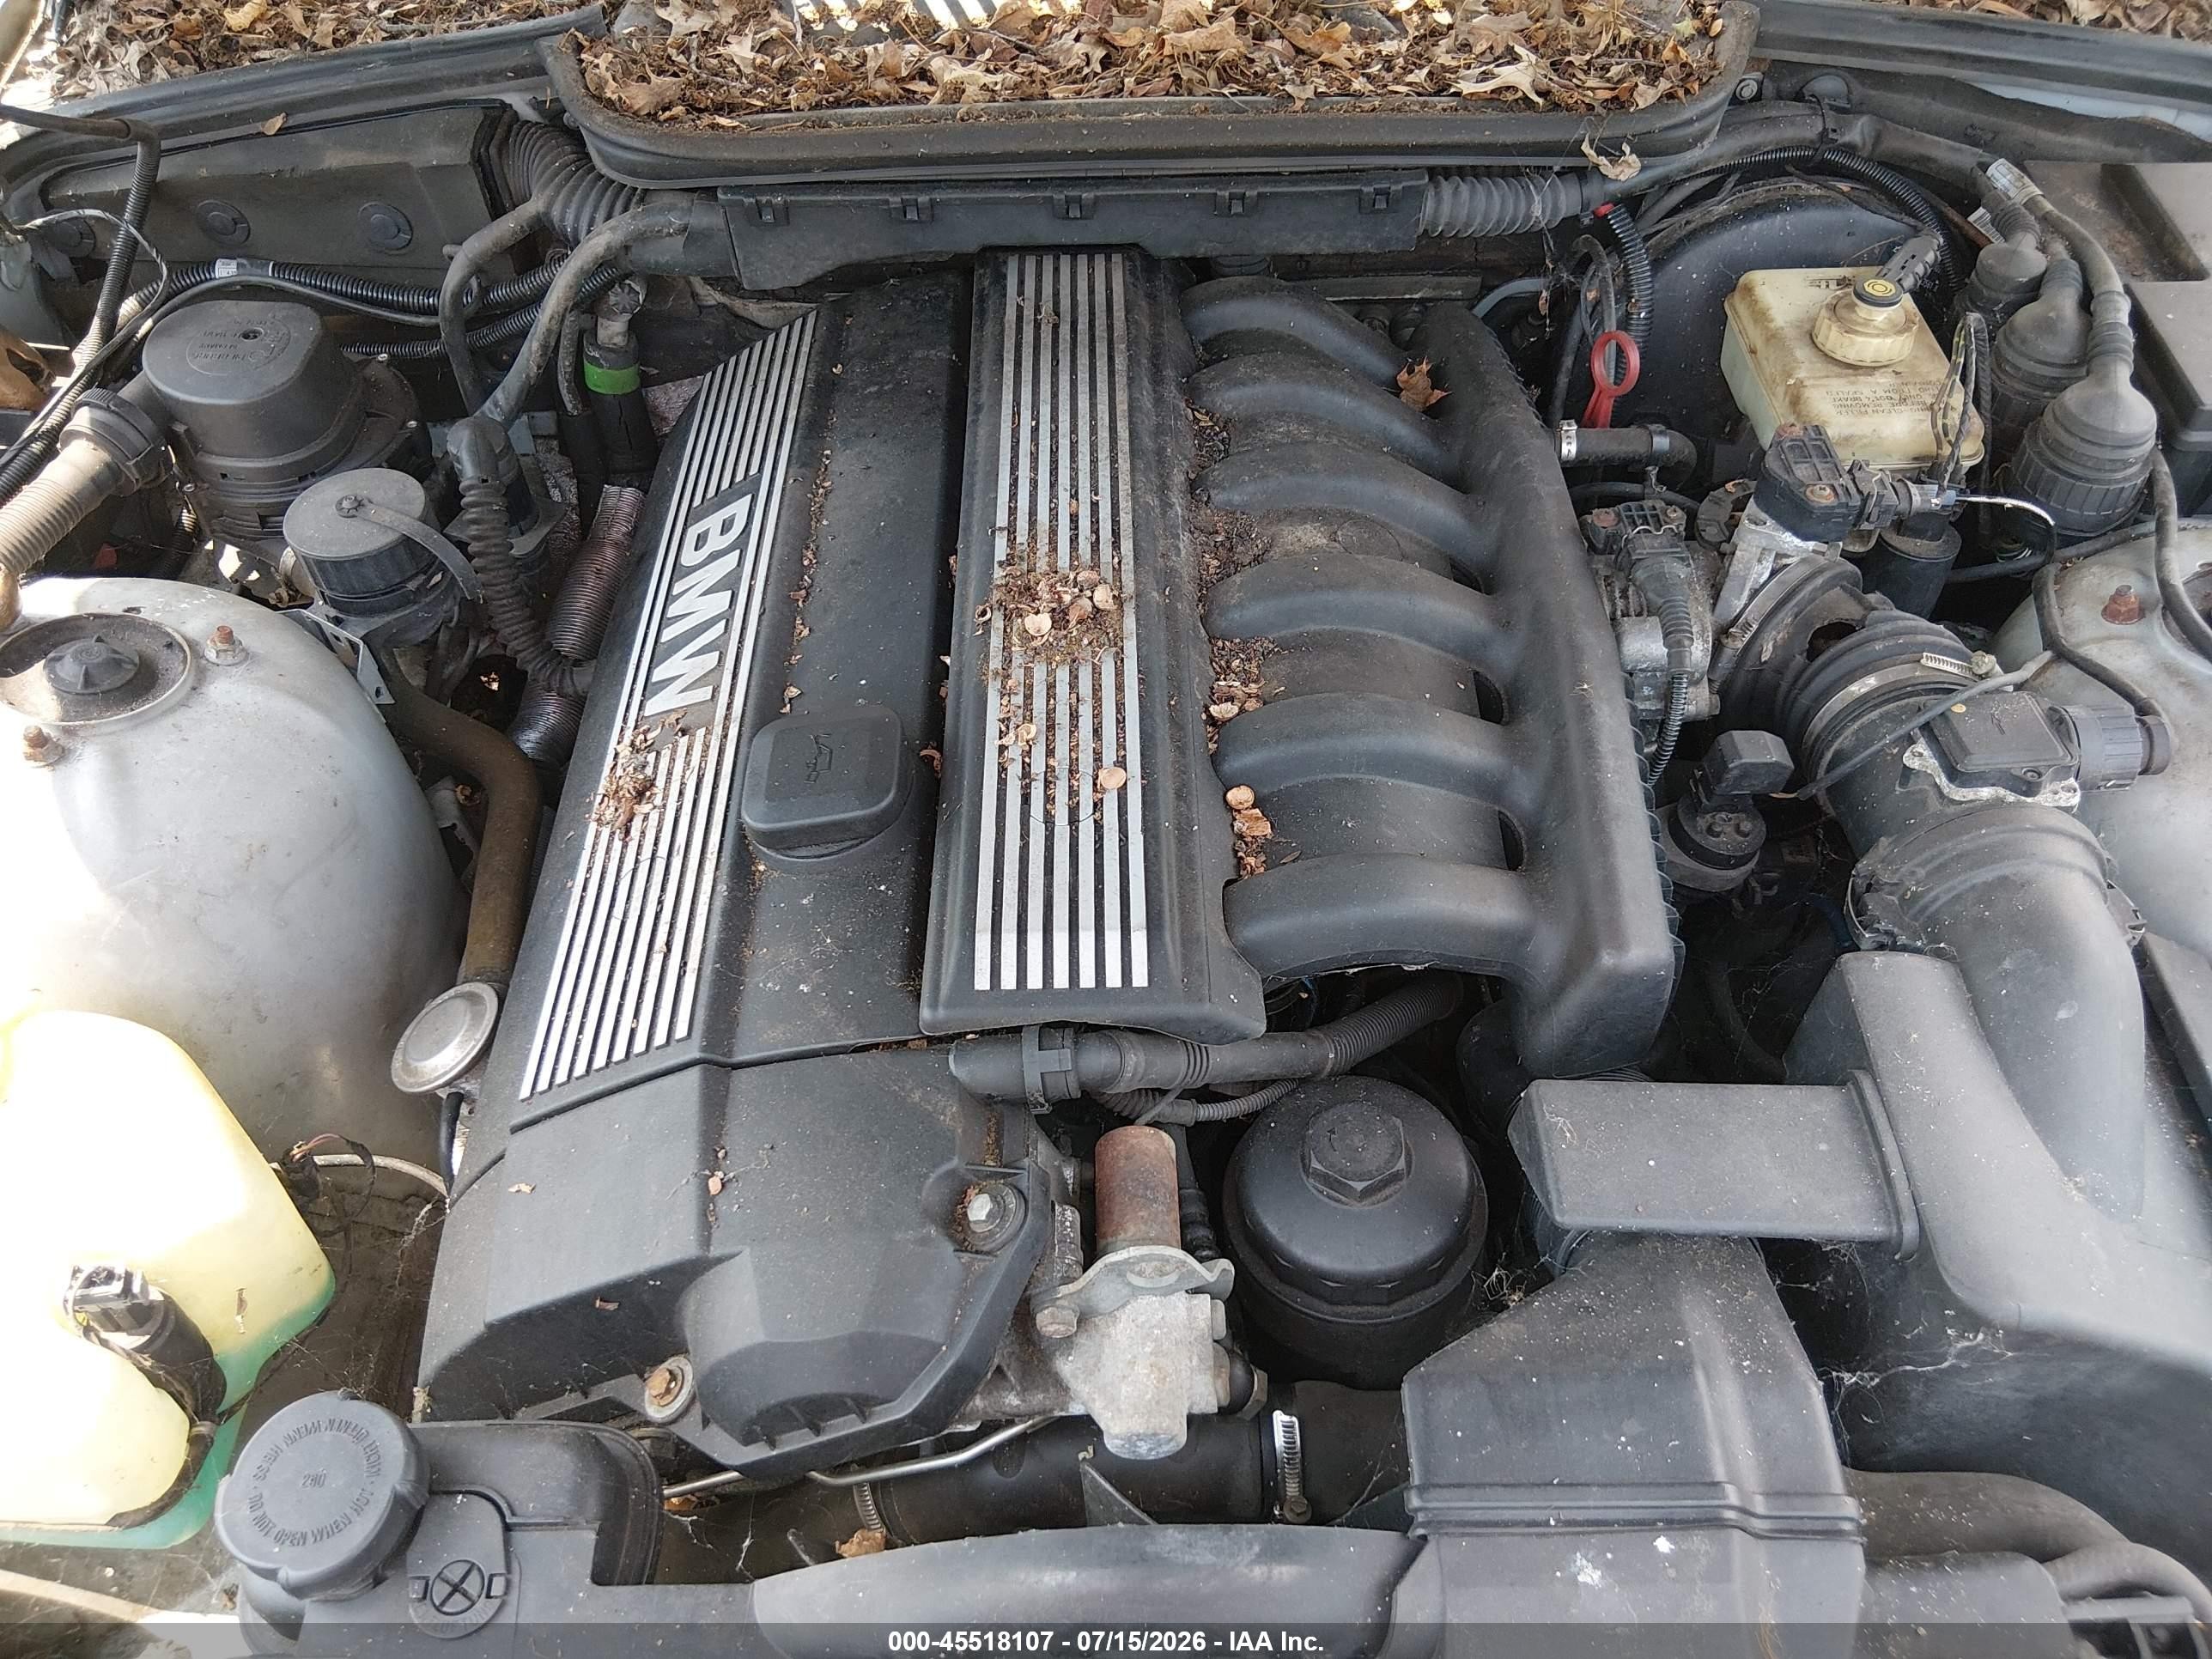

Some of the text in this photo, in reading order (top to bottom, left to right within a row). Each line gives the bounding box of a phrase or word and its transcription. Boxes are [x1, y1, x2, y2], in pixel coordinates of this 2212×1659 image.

[644, 493, 752, 716] BMW
[247, 1488, 374, 1547] DO NOT OPEN WHEN HOT
